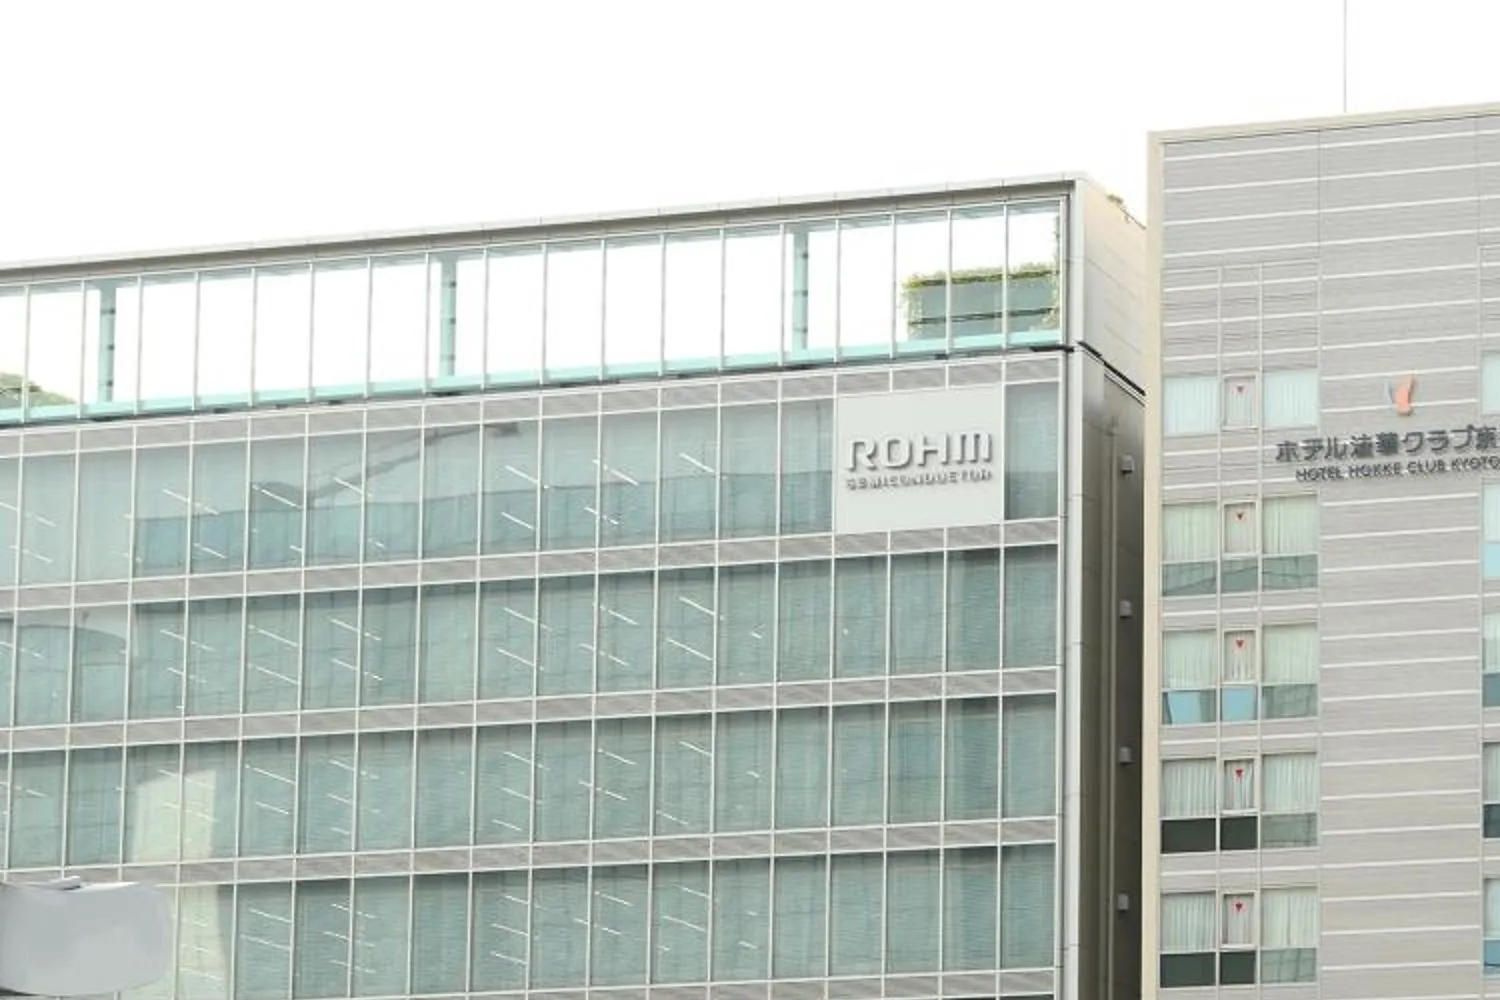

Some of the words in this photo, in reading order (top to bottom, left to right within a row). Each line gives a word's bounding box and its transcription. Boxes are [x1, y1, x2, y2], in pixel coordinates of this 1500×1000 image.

[1296, 463, 1345, 482] HOTEL
[1350, 459, 1401, 478] HOKKE
[1407, 458, 1447, 475] CLUB
